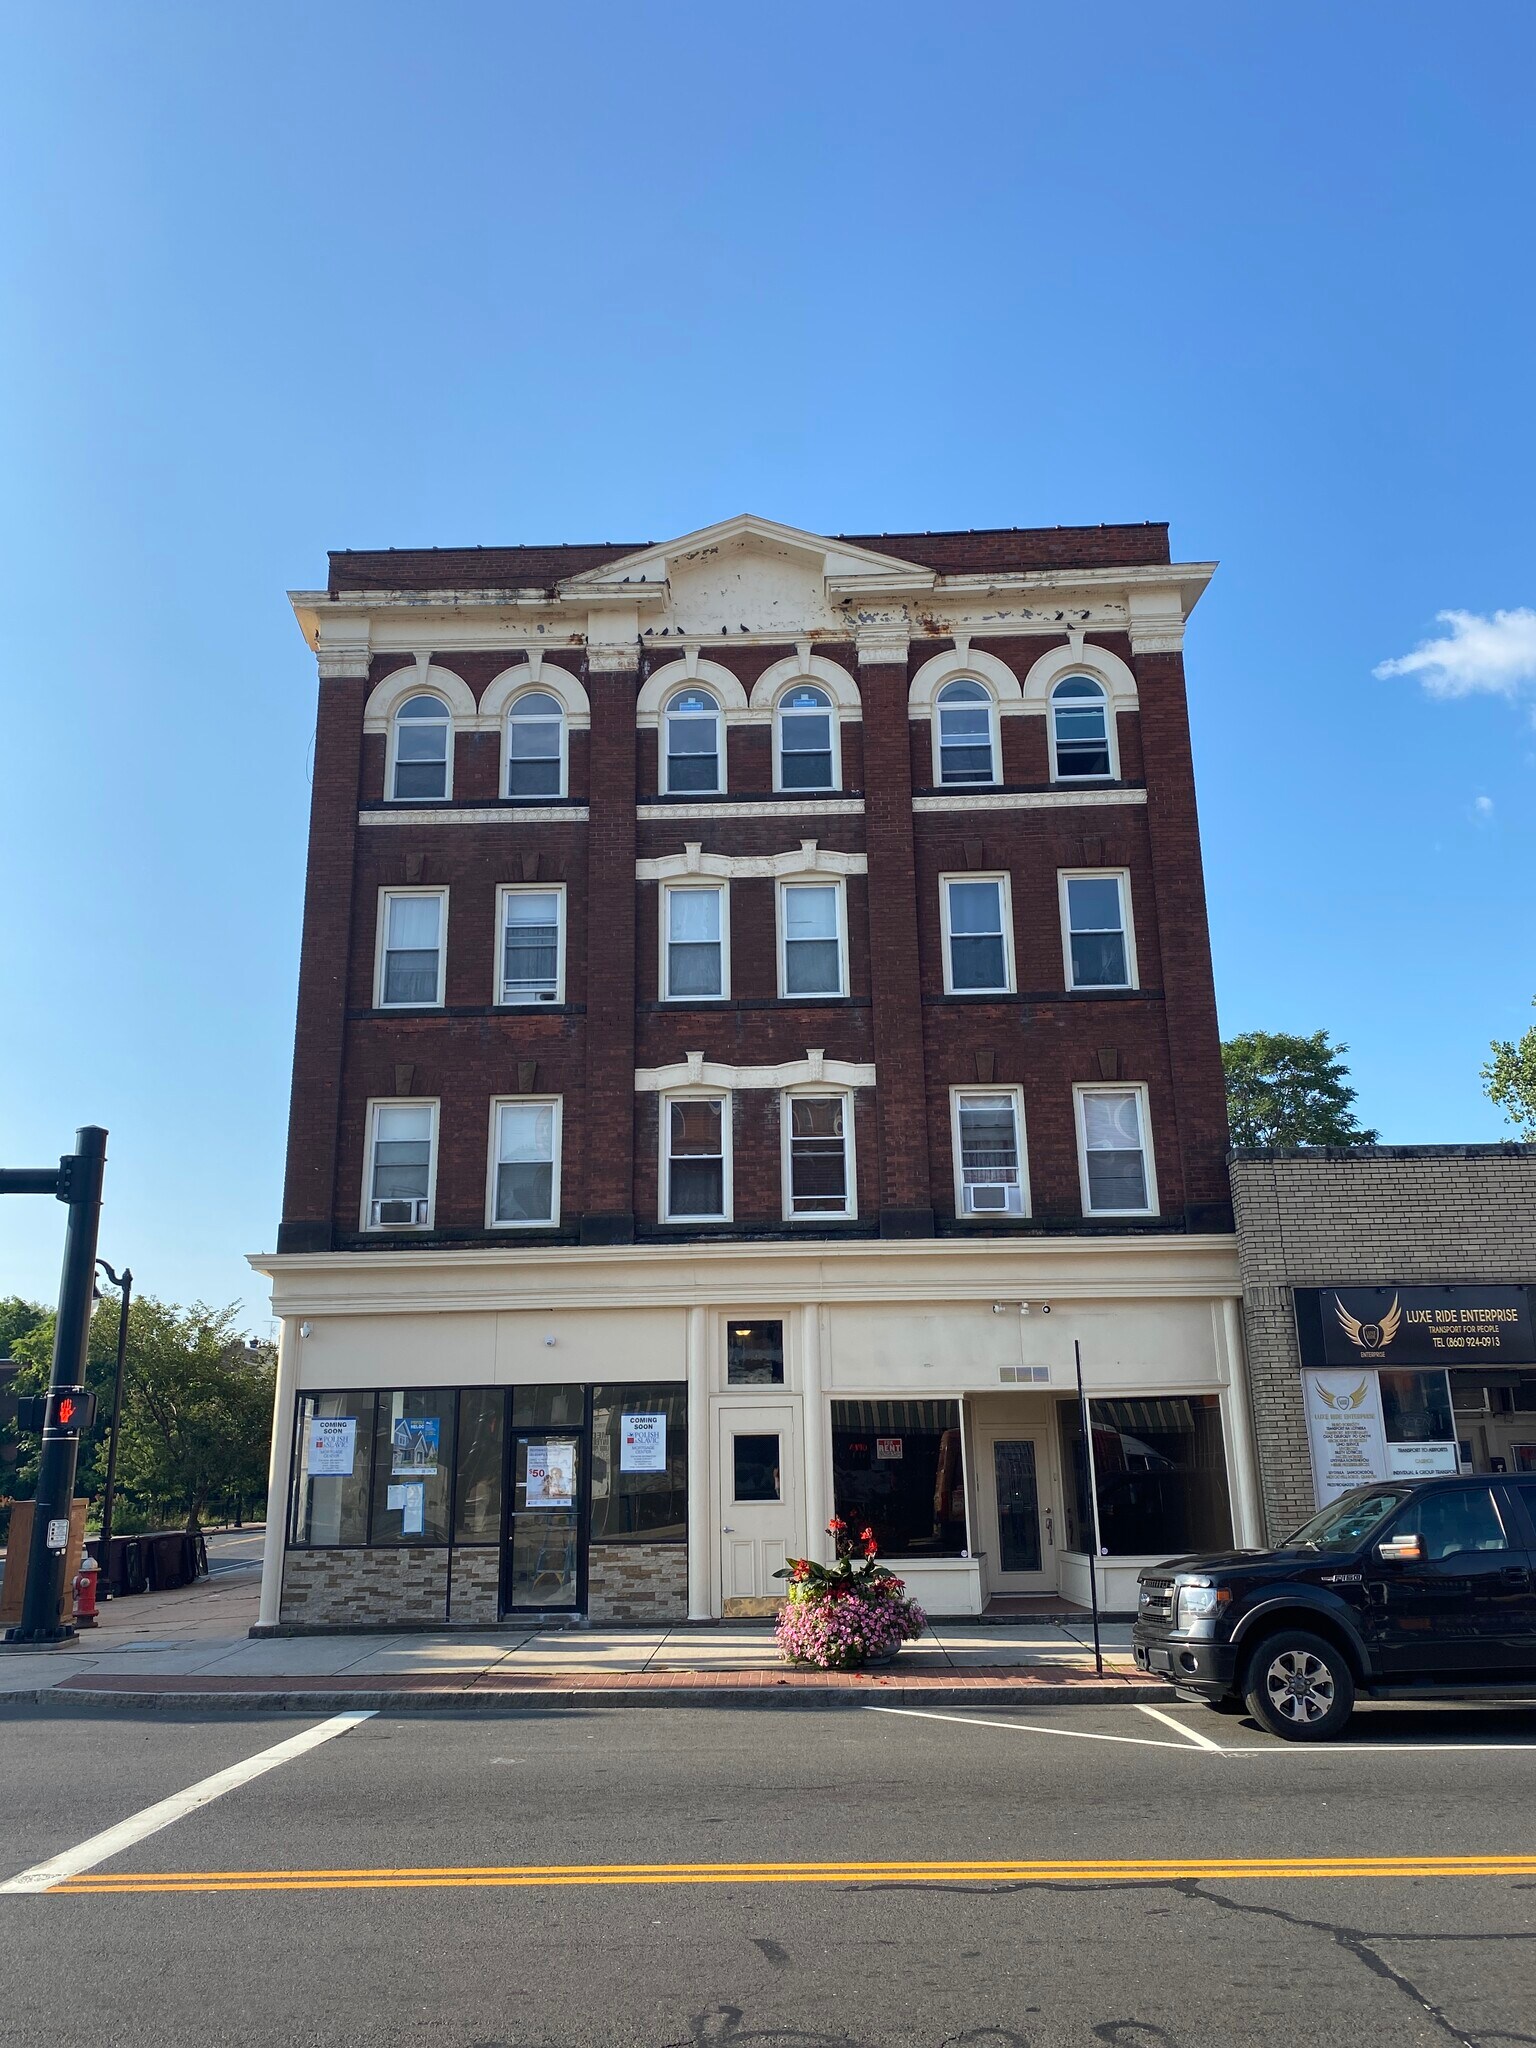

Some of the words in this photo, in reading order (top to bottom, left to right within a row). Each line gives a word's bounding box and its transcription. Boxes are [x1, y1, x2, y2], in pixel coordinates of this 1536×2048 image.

[1406, 1310, 1432, 1323] LUXE
[1435, 1310, 1457, 1322] RIDE
[1460, 1309, 1518, 1322] ENTERPRISE
[1433, 1338, 1445, 1347] TEL
[1446, 1337, 1465, 1347] (860)
[1466, 1336, 1500, 1347] 924-0913
[323, 1435, 349, 1443] POLISH
[635, 1431, 660, 1439] POLISH
[879, 1444, 901, 1452] RENT
[528, 1468, 545, 1478] $50
